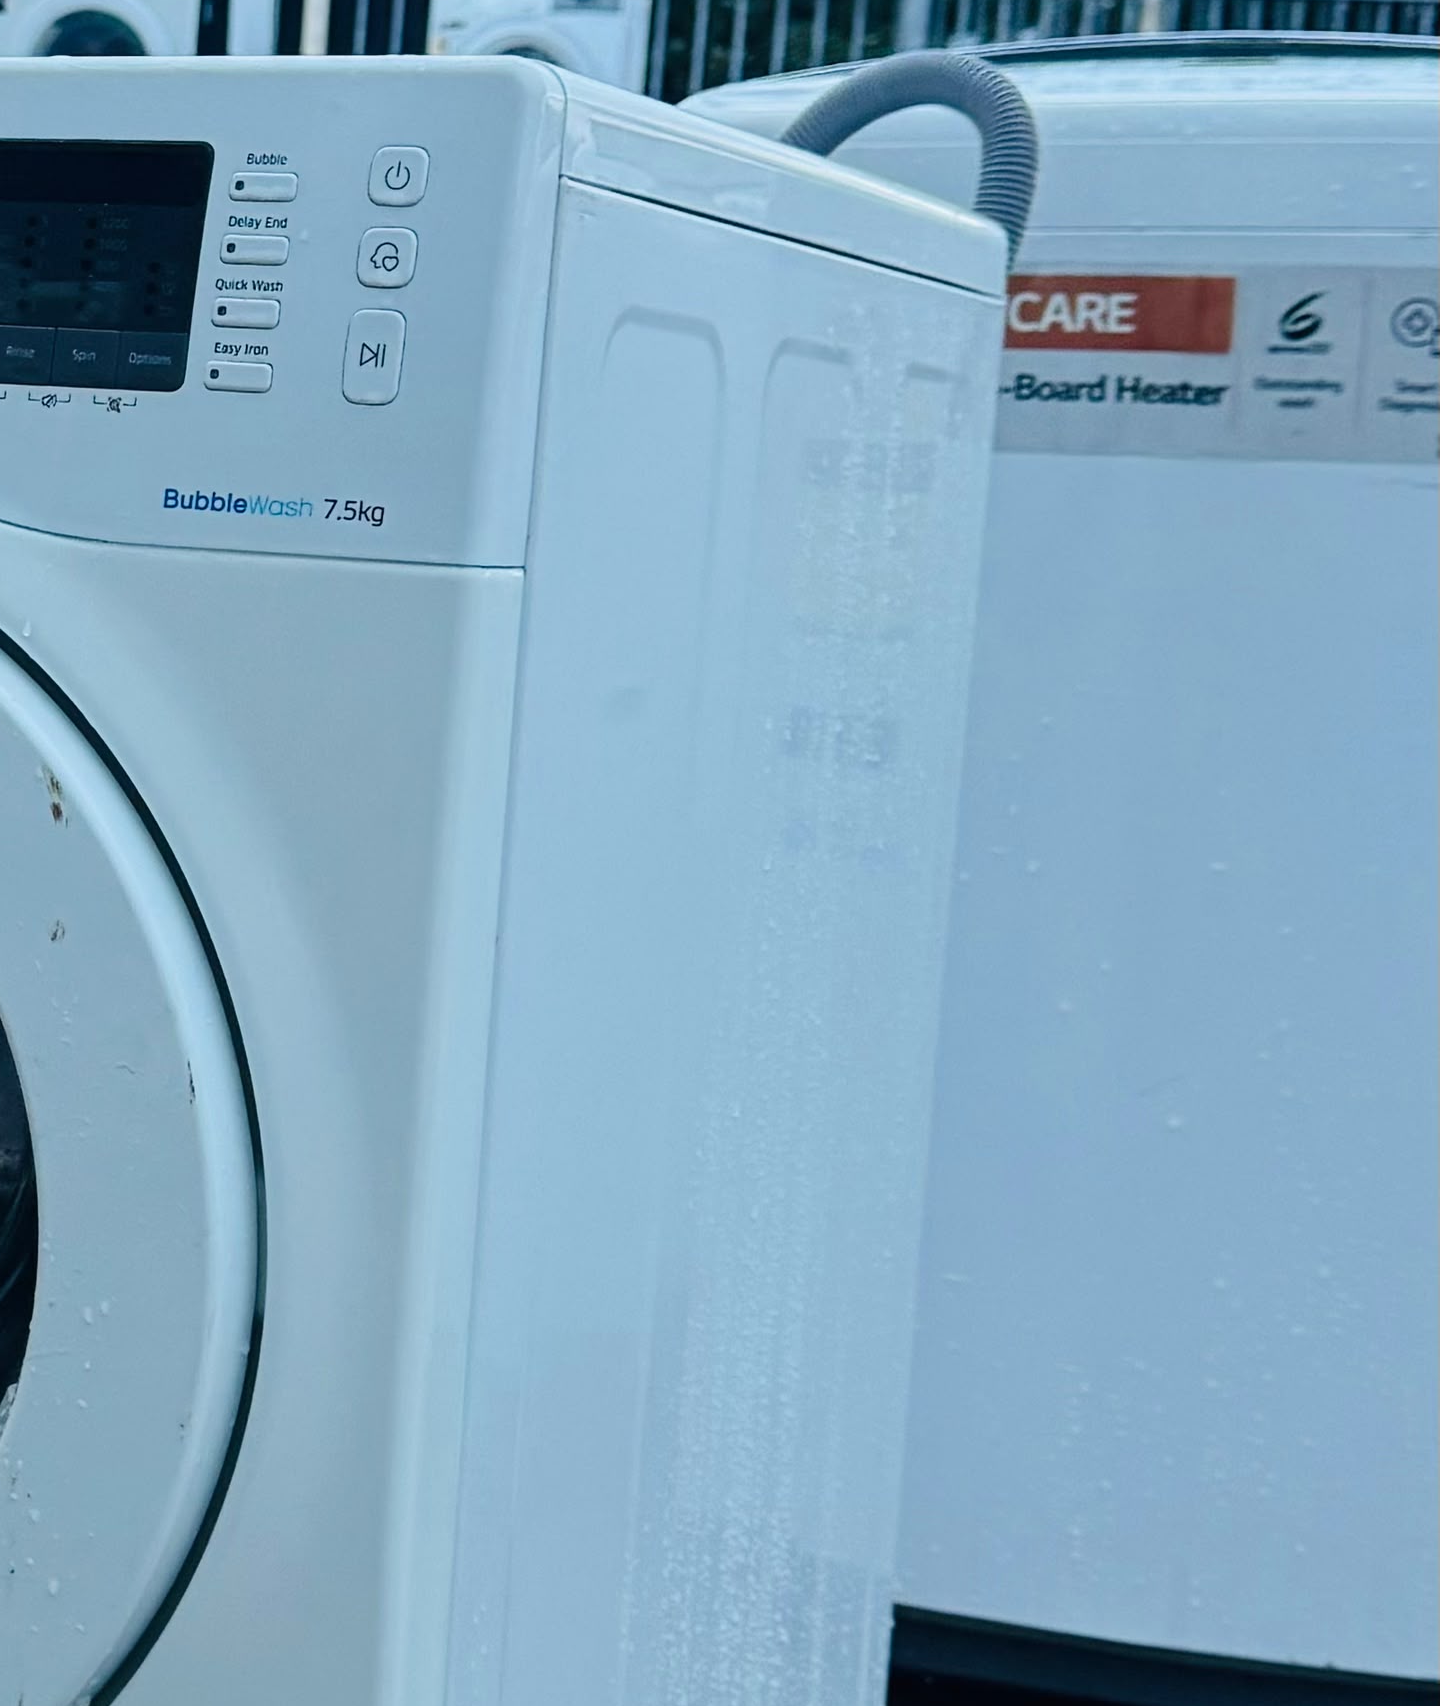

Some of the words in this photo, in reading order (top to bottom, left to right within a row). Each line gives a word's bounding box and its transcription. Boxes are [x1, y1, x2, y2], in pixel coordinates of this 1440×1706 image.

[246, 153, 288, 165] Bubble
[228, 215, 262, 230] Delay
[265, 216, 288, 229] End
[215, 278, 248, 292] Quick
[251, 280, 284, 292] Wash
[1010, 291, 1139, 334] CARE
[72, 348, 96, 363] Spin
[214, 341, 242, 356] Easy
[244, 343, 269, 355] Iron
[128, 352, 172, 366] Options
[1116, 376, 1230, 406] Heater
[323, 498, 385, 527] 7.5kg
